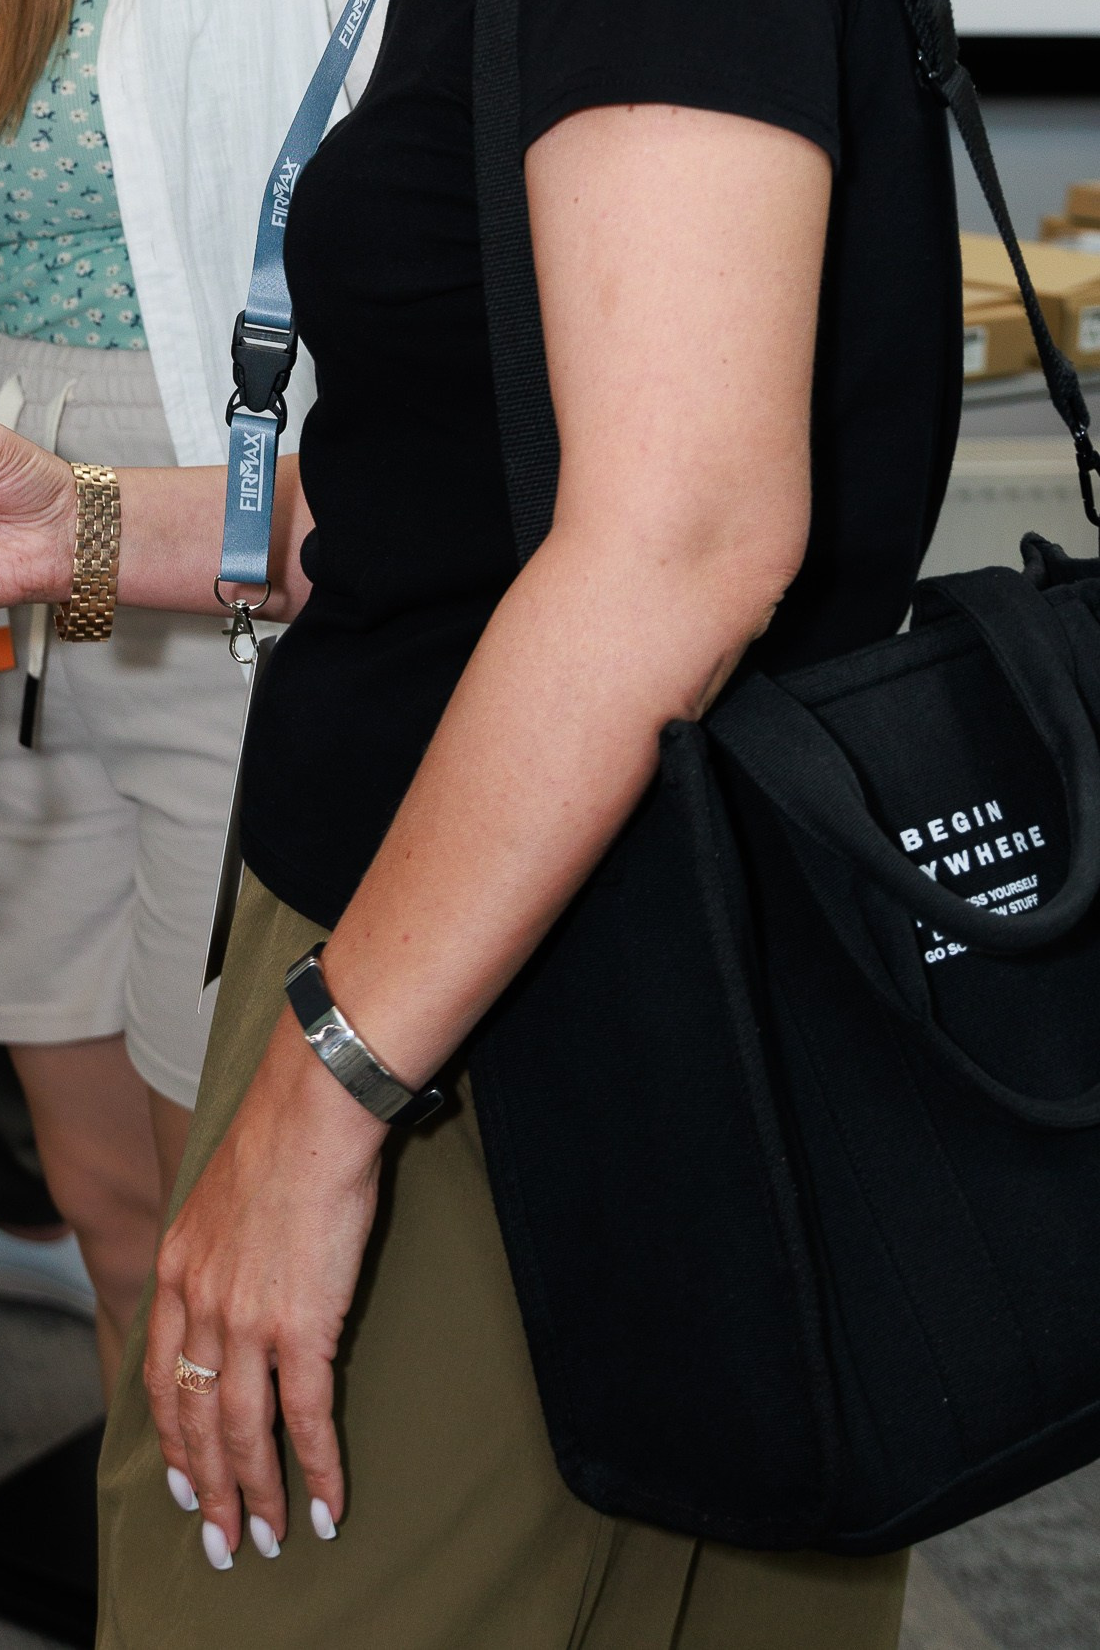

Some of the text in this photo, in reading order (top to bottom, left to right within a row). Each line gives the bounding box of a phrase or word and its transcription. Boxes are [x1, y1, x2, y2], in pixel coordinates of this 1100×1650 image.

[271, 156, 298, 227] FIRMAX
[239, 432, 264, 512] FIRMAX
[900, 800, 1003, 852] BEGIN
[919, 825, 1046, 882] YWHERE
[965, 874, 1038, 907] SS YOURSELF
[1008, 893, 1038, 914] STUFF
[924, 947, 946, 964] GO
